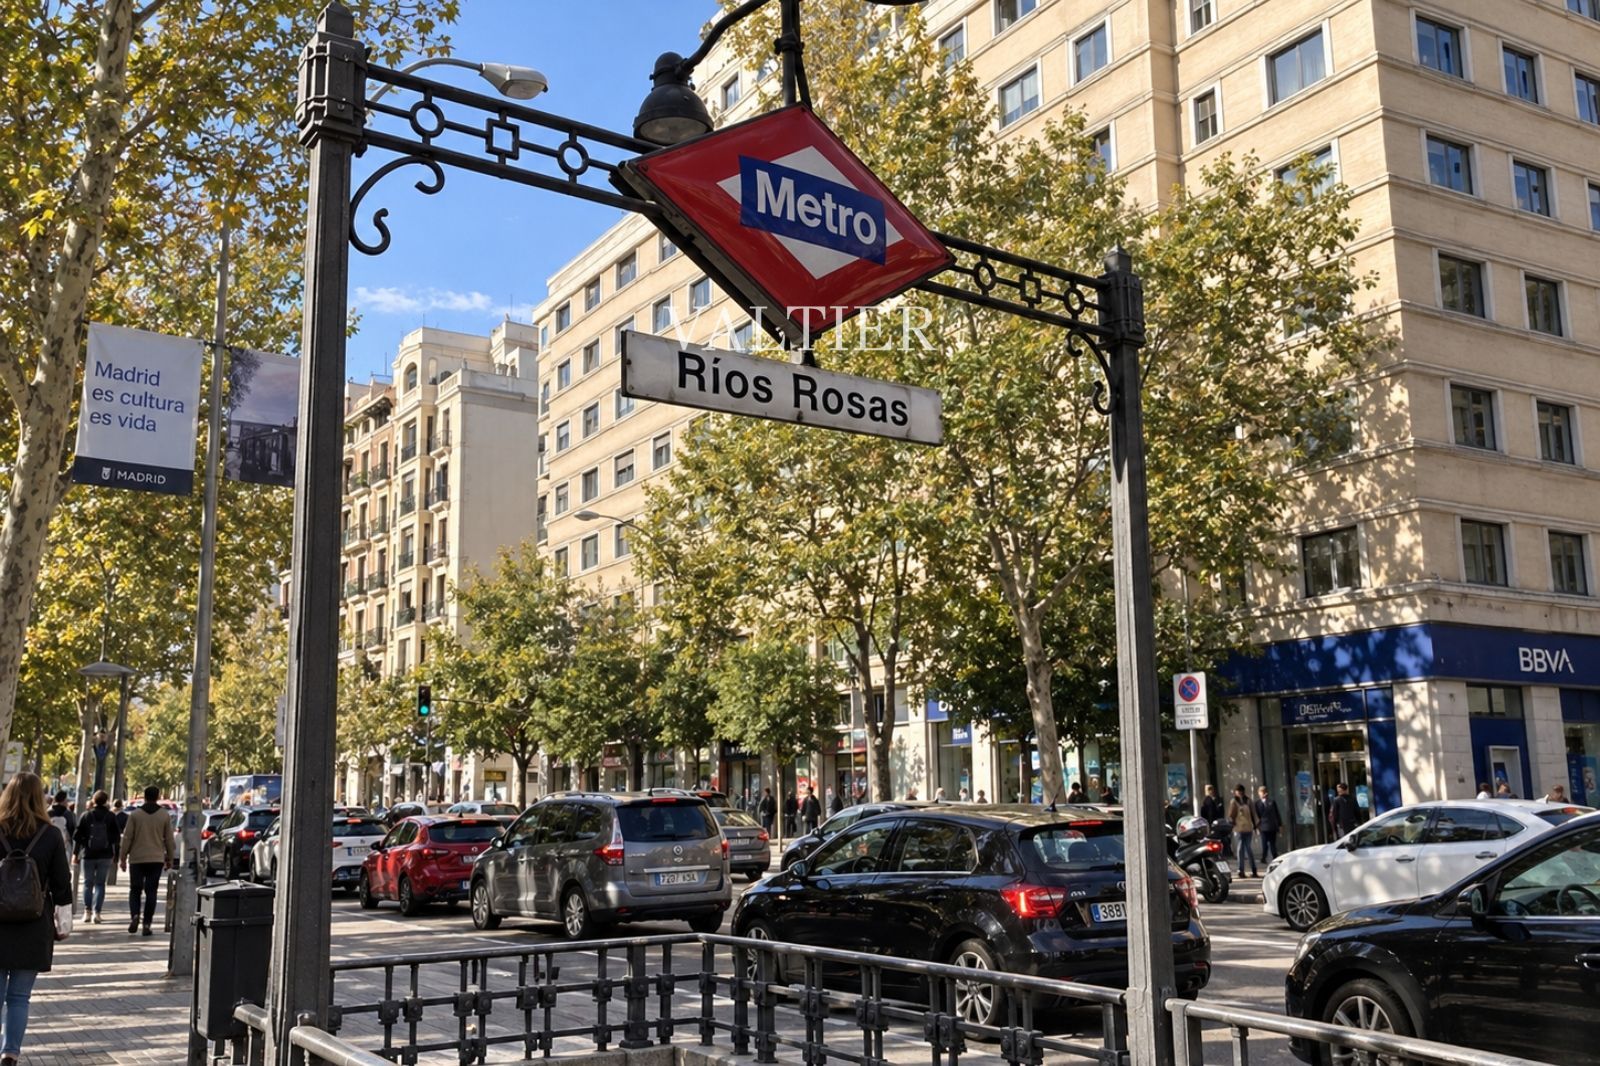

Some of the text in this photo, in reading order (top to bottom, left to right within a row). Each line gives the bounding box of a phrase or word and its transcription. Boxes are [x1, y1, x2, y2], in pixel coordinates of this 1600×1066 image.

[755, 168, 878, 246] Metro
[95, 360, 161, 387] Madrid
[92, 387, 185, 414] es cultura
[677, 351, 910, 427] Ríos Rosas
[89, 411, 157, 433] es vida
[117, 470, 167, 485] MADRID
[1518, 646, 1575, 674] BBVA
